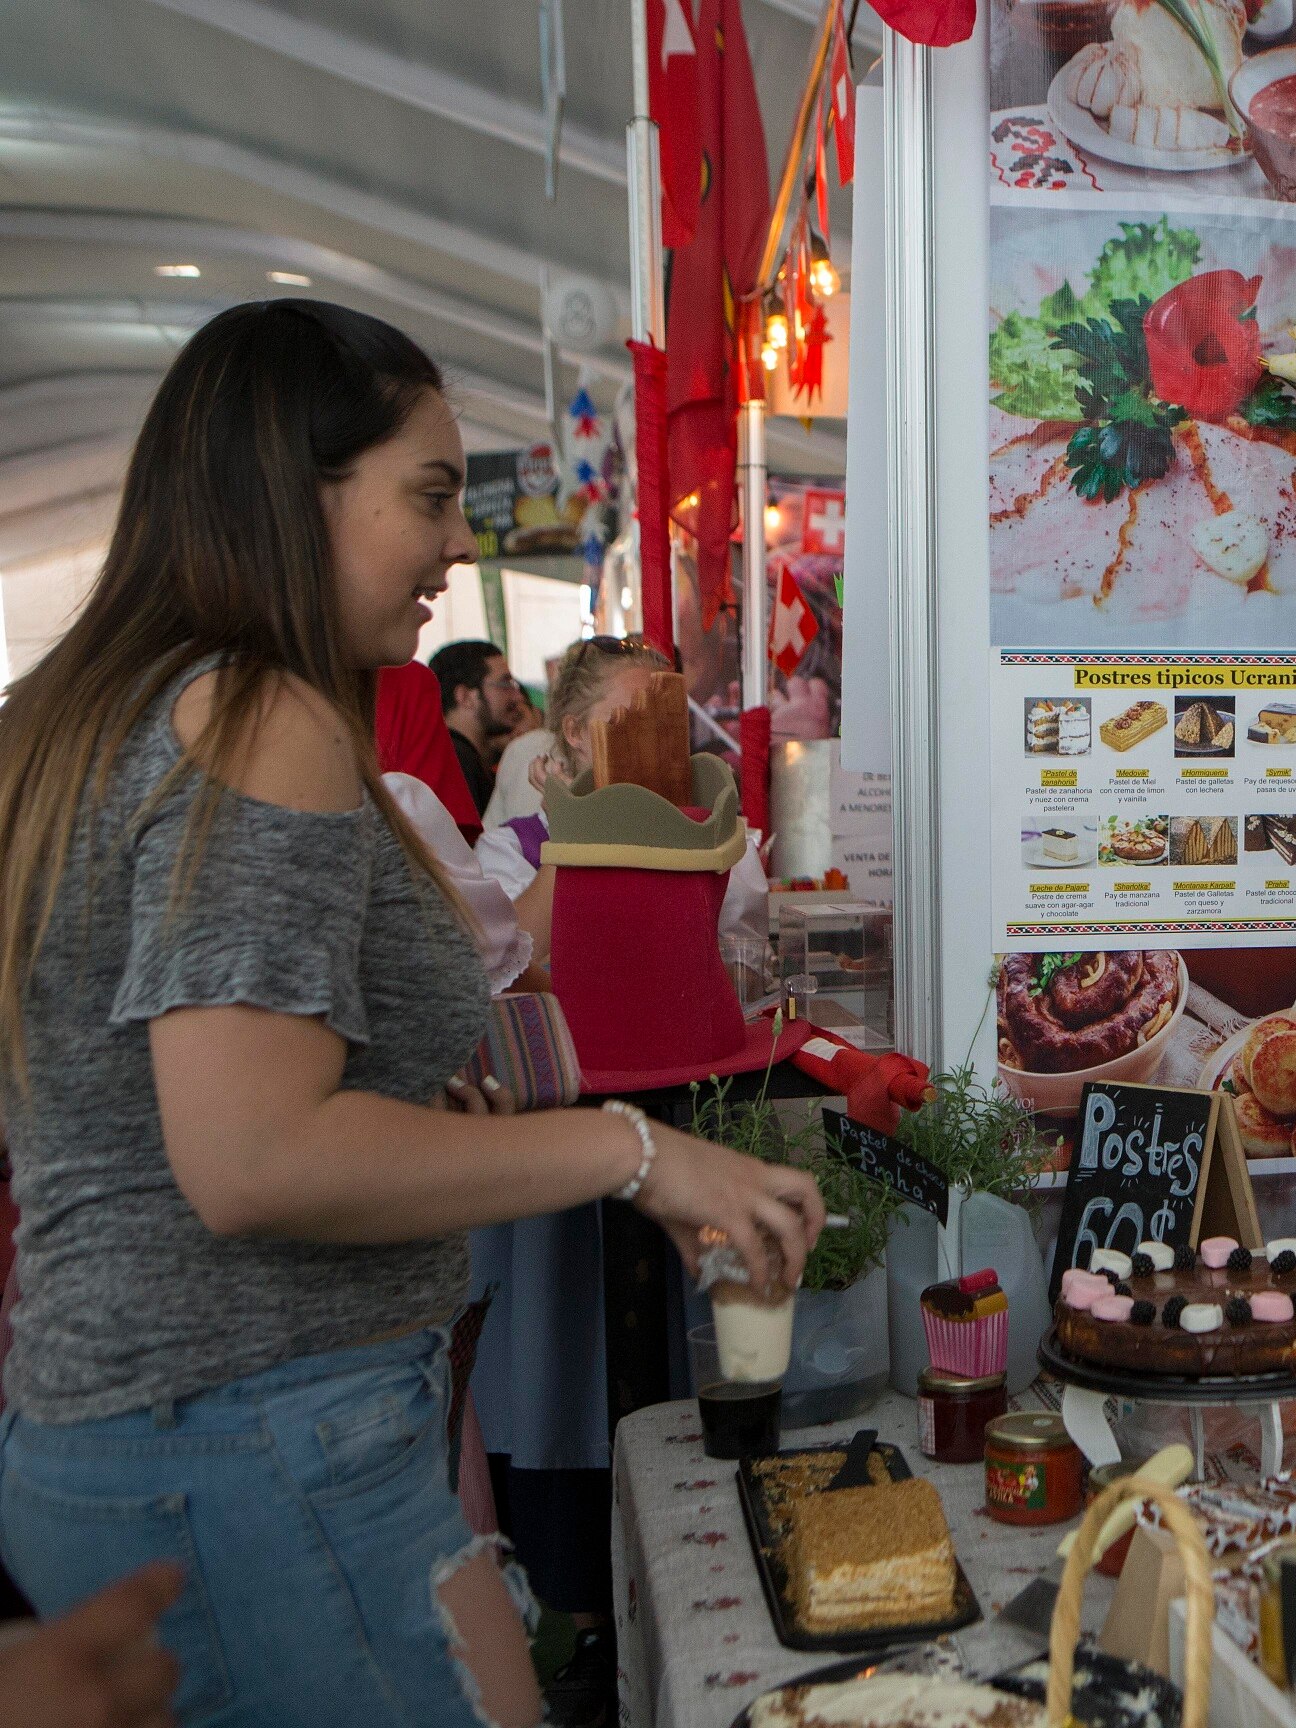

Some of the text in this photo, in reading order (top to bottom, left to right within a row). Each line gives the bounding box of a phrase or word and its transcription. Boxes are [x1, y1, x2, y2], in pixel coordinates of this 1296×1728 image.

[1074, 668, 1151, 685] Postres
[1157, 668, 1224, 688] tipicos
[1208, 778, 1234, 786] galletas
[1244, 778, 1257, 786] Pay
[1043, 804, 1075, 812] pastelera
[844, 853, 875, 862] VENTA
[1104, 892, 1120, 900] Pay
[1174, 890, 1195, 898] Pastel
[1062, 902, 1094, 910] agar-agar
[1116, 900, 1150, 908] tradicional
[1198, 900, 1218, 908] queso
[1078, 1092, 1203, 1197] Postres
